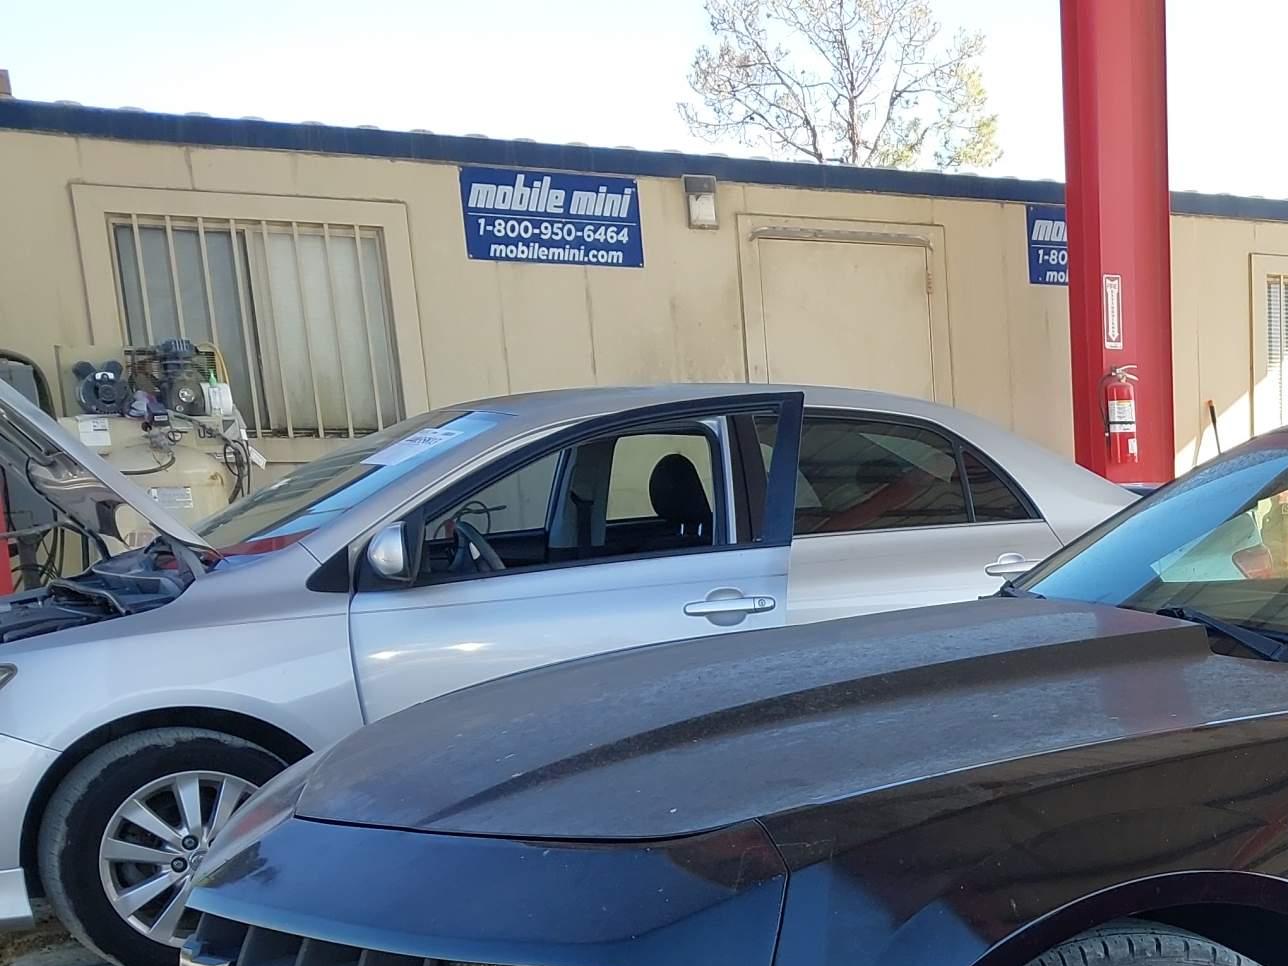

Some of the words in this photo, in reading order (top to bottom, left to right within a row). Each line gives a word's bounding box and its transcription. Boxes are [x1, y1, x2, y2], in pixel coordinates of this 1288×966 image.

[467, 174, 565, 214] mobile
[569, 186, 632, 218] mini
[477, 218, 629, 244] 1-800-950-6464
[1031, 219, 1068, 242] mo
[489, 242, 623, 264] mobilemini.com
[1045, 269, 1069, 283] mo
